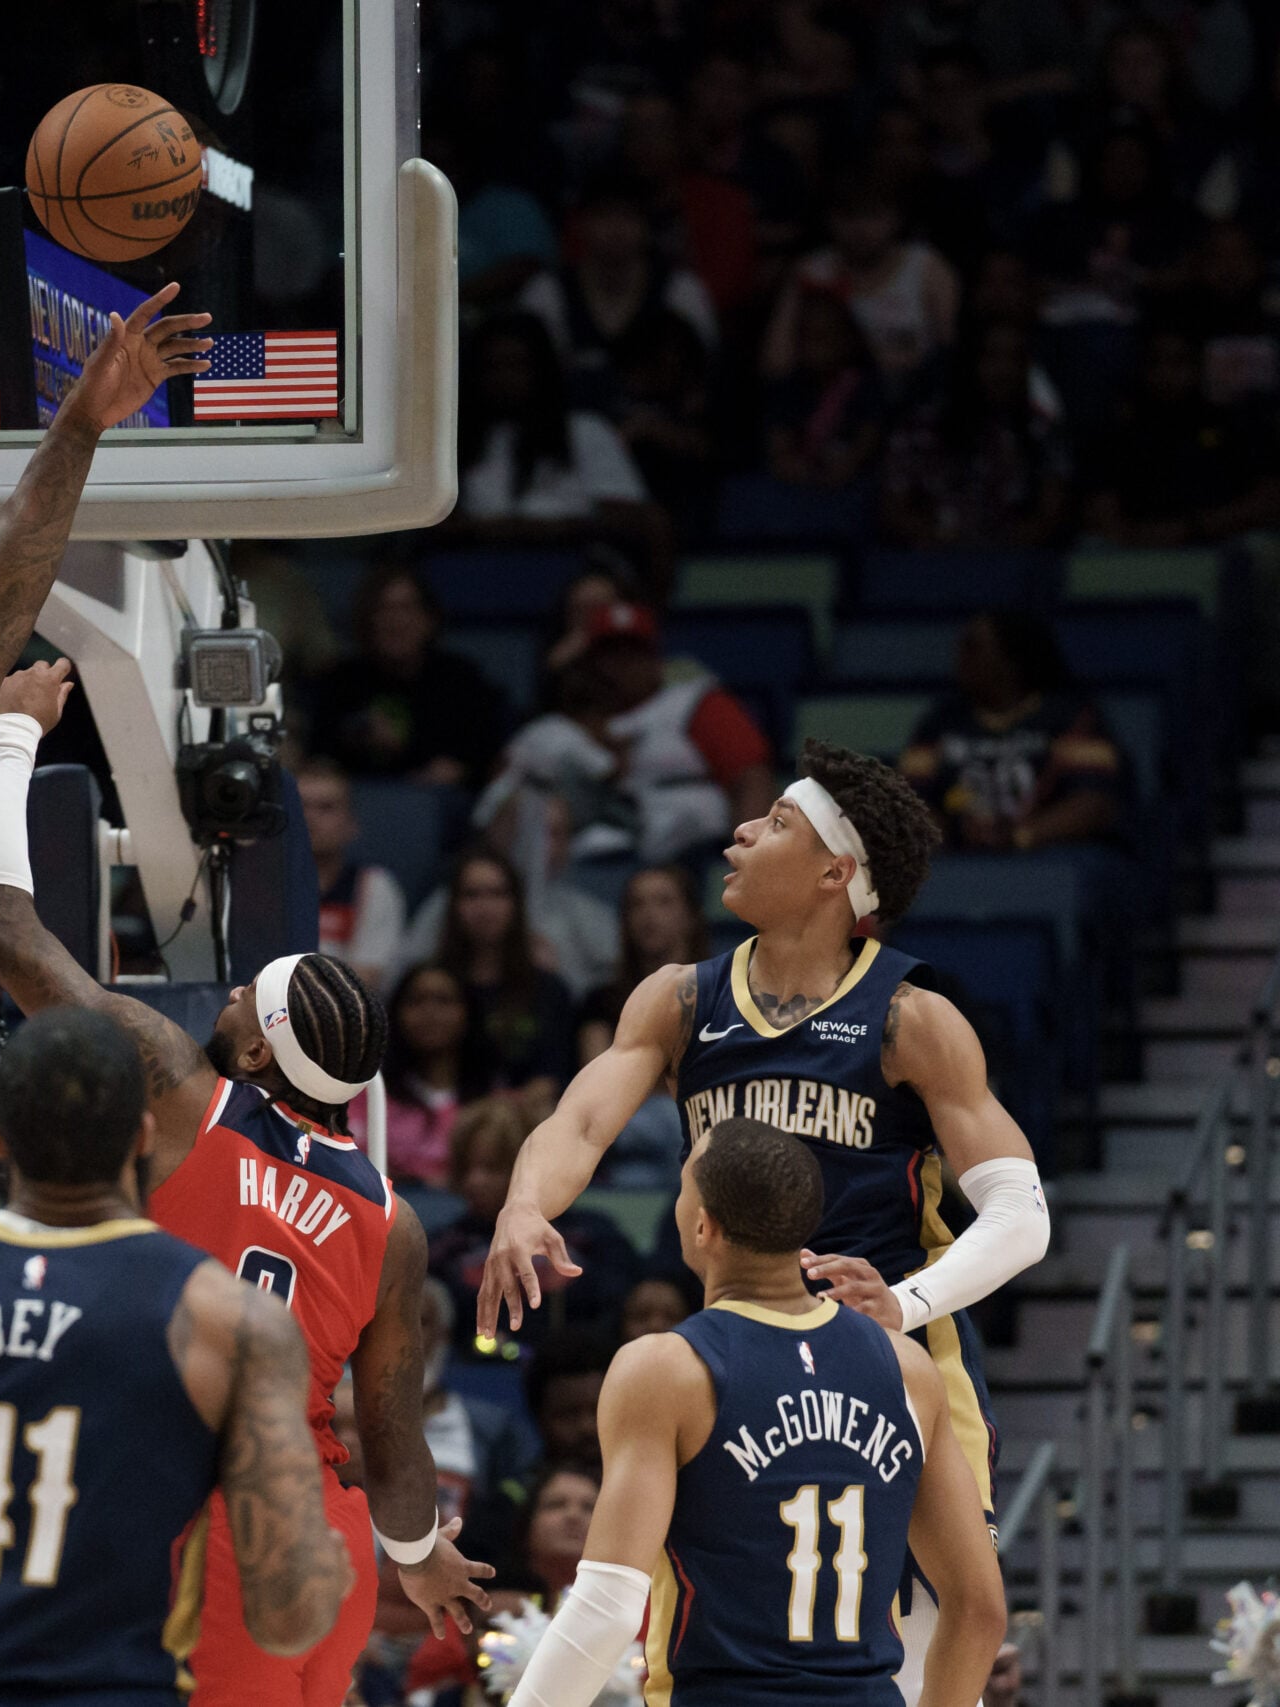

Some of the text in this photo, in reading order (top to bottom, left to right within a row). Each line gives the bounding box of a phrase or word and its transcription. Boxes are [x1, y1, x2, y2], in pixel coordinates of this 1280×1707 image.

[28, 274, 61, 351] NEW
[811, 1020, 868, 1035] NEWAGE
[820, 1033, 856, 1044] GARAGE
[744, 1079, 876, 1149] ORLEANS
[239, 1158, 351, 1246] HARDY
[722, 1389, 913, 1484] McGOWENS
[779, 1484, 868, 1642] 11
